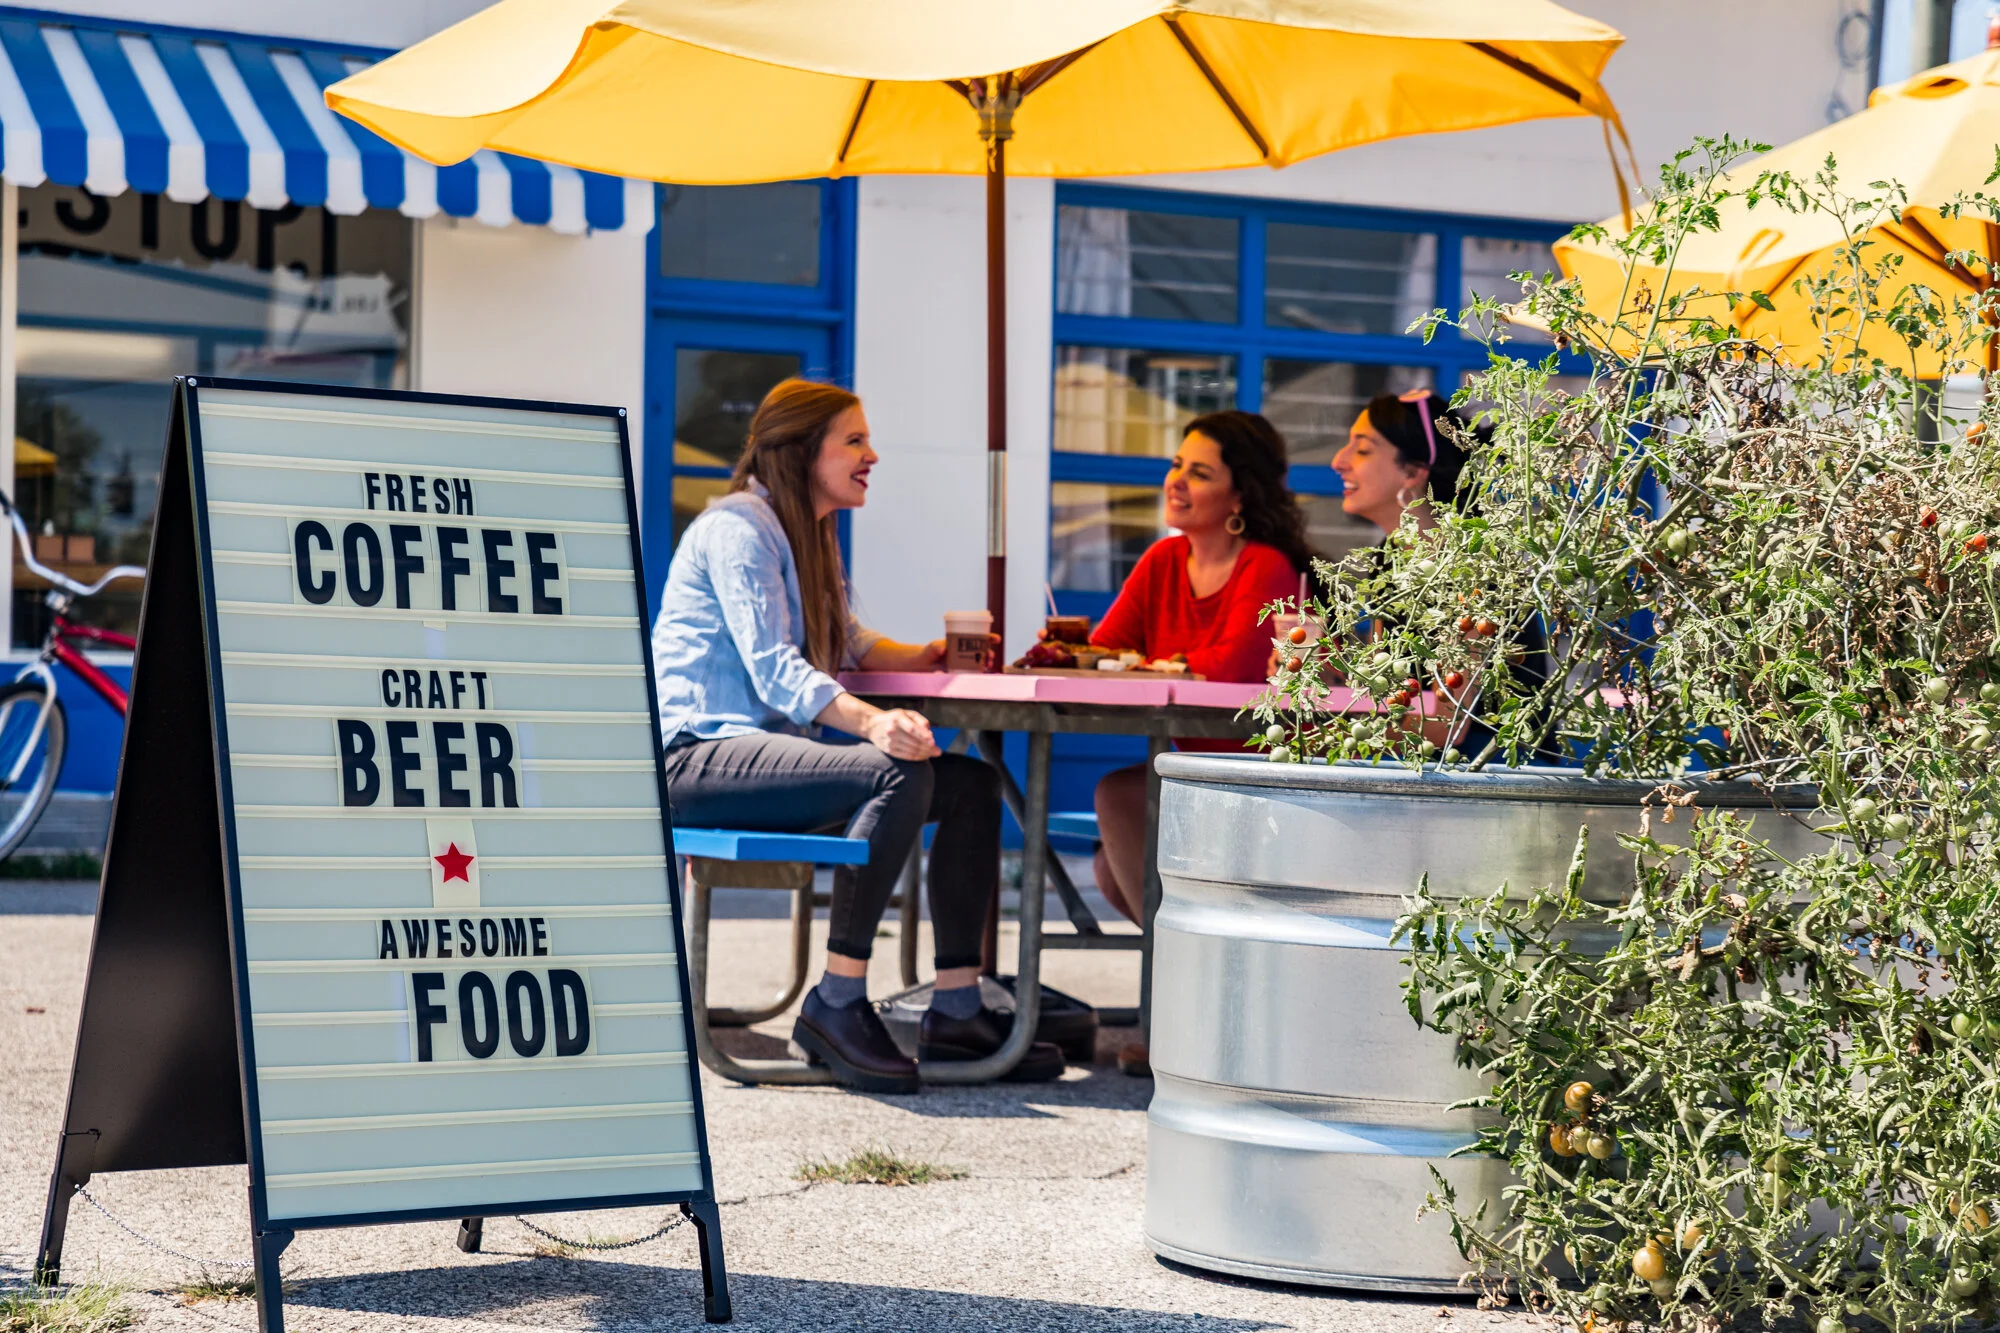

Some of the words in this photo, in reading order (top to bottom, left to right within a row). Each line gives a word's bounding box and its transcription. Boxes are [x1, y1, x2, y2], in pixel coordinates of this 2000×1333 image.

[364, 472, 474, 516] FRESH
[294, 520, 563, 616] COFFEE
[381, 668, 488, 710] CRAFT
[336, 719, 520, 809] BEER
[379, 917, 548, 960] AWESOME
[411, 968, 591, 1063] FOOD
